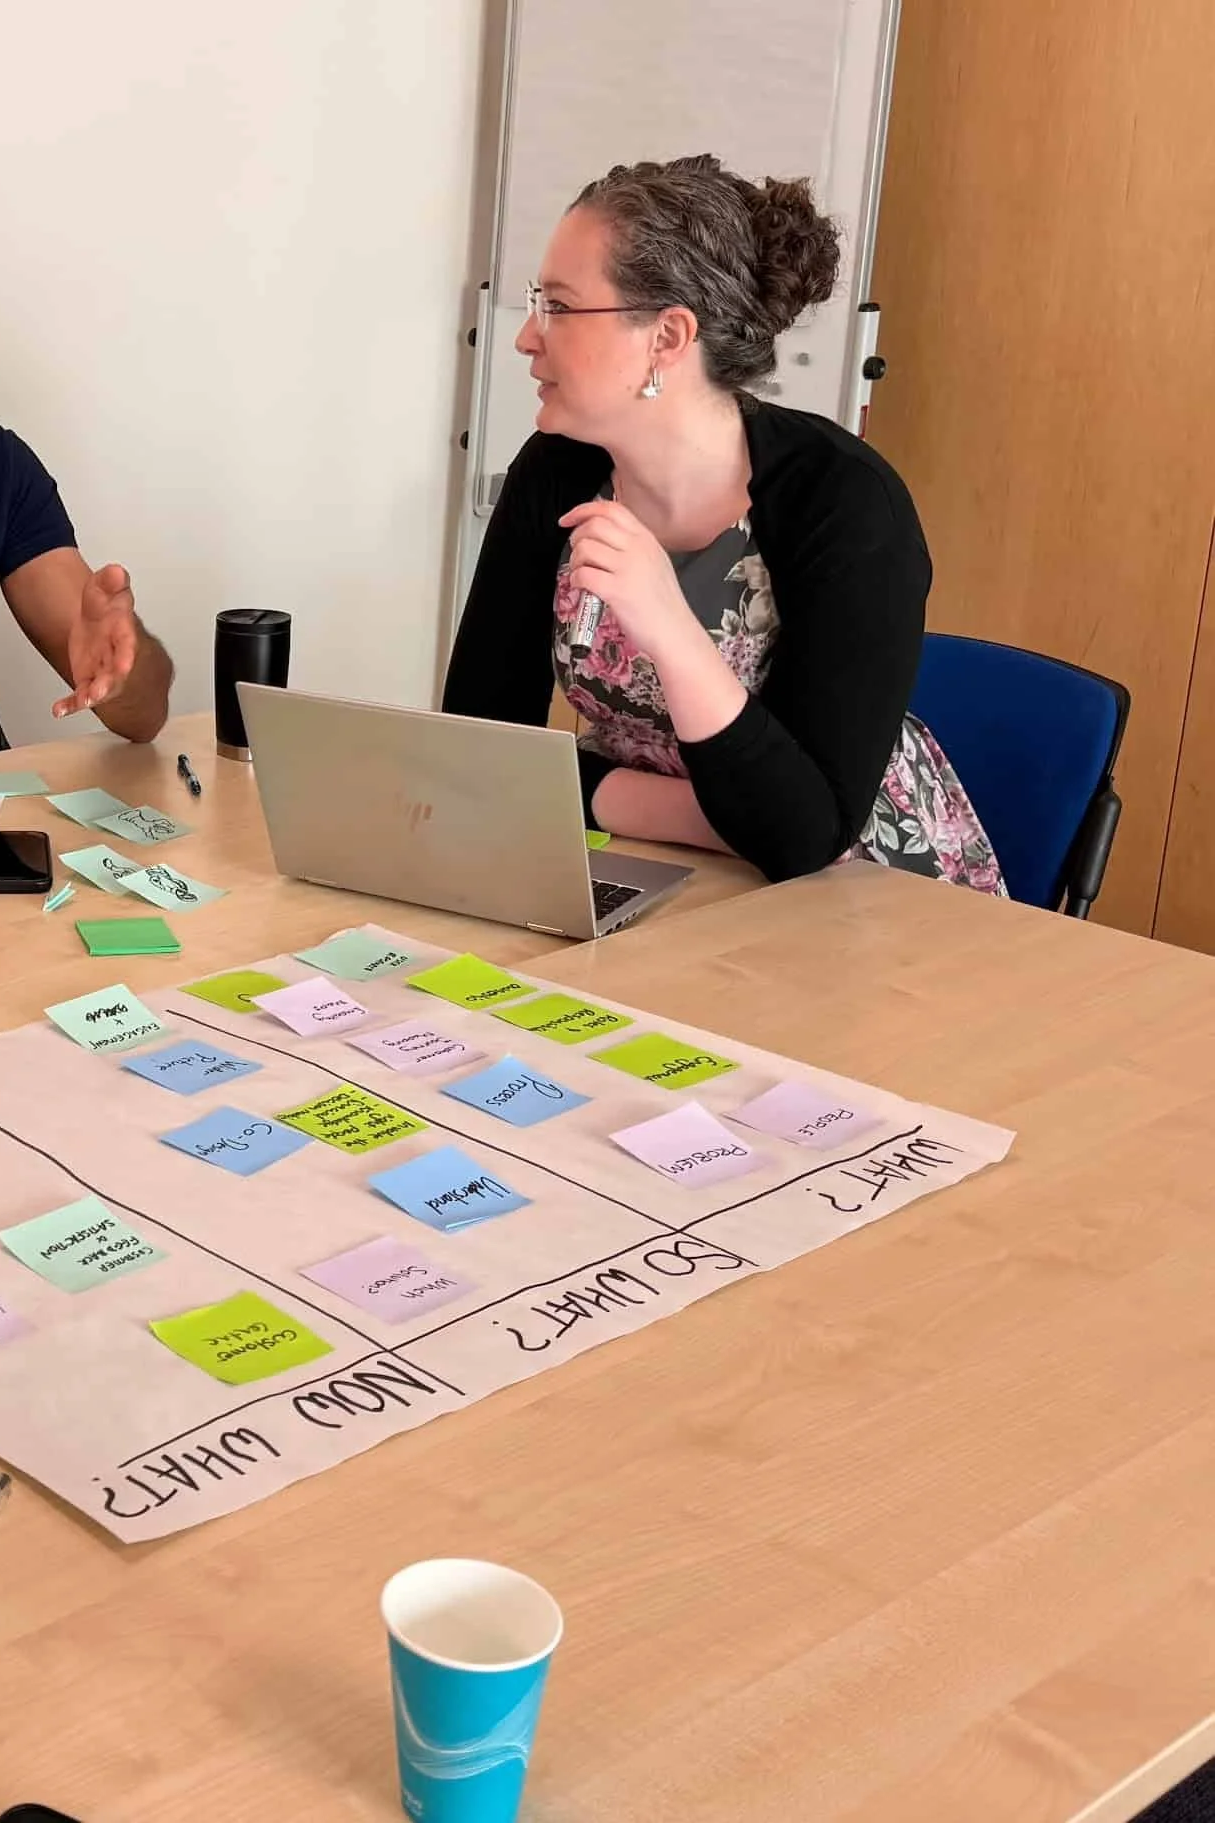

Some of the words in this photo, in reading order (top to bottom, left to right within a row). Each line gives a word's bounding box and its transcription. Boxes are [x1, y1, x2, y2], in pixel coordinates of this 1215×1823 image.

[154, 1052, 216, 1072] Picture
[484, 1073, 564, 1109] Process
[797, 1107, 854, 1137] PEOPLE
[657, 1141, 747, 1176] PROBLEM
[424, 1175, 507, 1216] Understand
[642, 1239, 744, 1287] SO
[400, 1277, 456, 1301] Which
[491, 1261, 639, 1354] WHAT?
[215, 1328, 297, 1364] Customer
[291, 1359, 435, 1431] NOW
[91, 1425, 281, 1519] WHAT?
